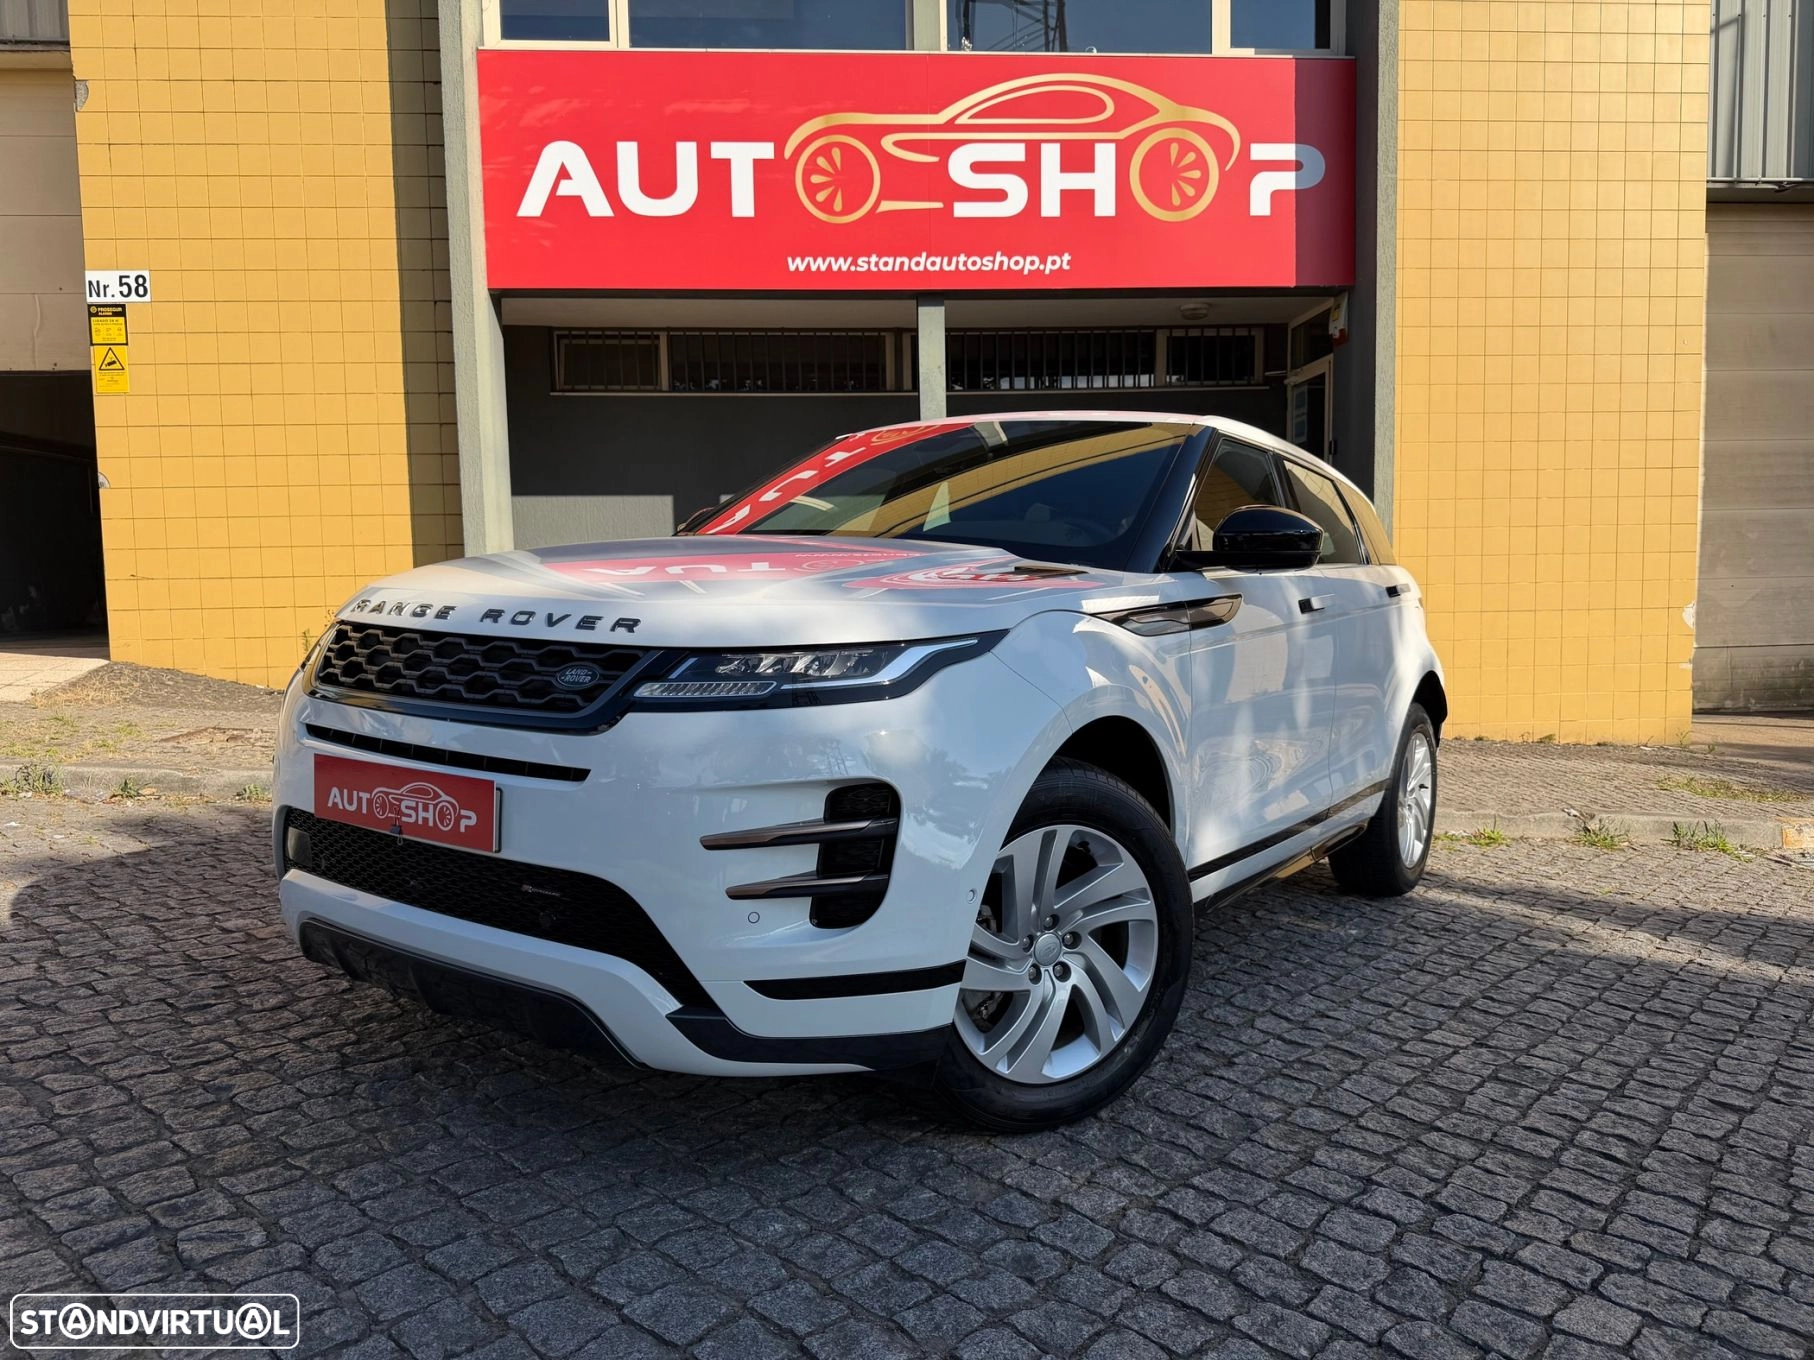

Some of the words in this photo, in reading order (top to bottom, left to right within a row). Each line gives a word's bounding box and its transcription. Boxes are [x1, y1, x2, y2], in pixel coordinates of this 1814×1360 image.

[787, 251, 1072, 276] www.standautoshop.pt
[88, 280, 115, 298] Nr.
[119, 274, 148, 298] 58
[351, 599, 457, 620] RANGE
[480, 608, 641, 634] ROVER
